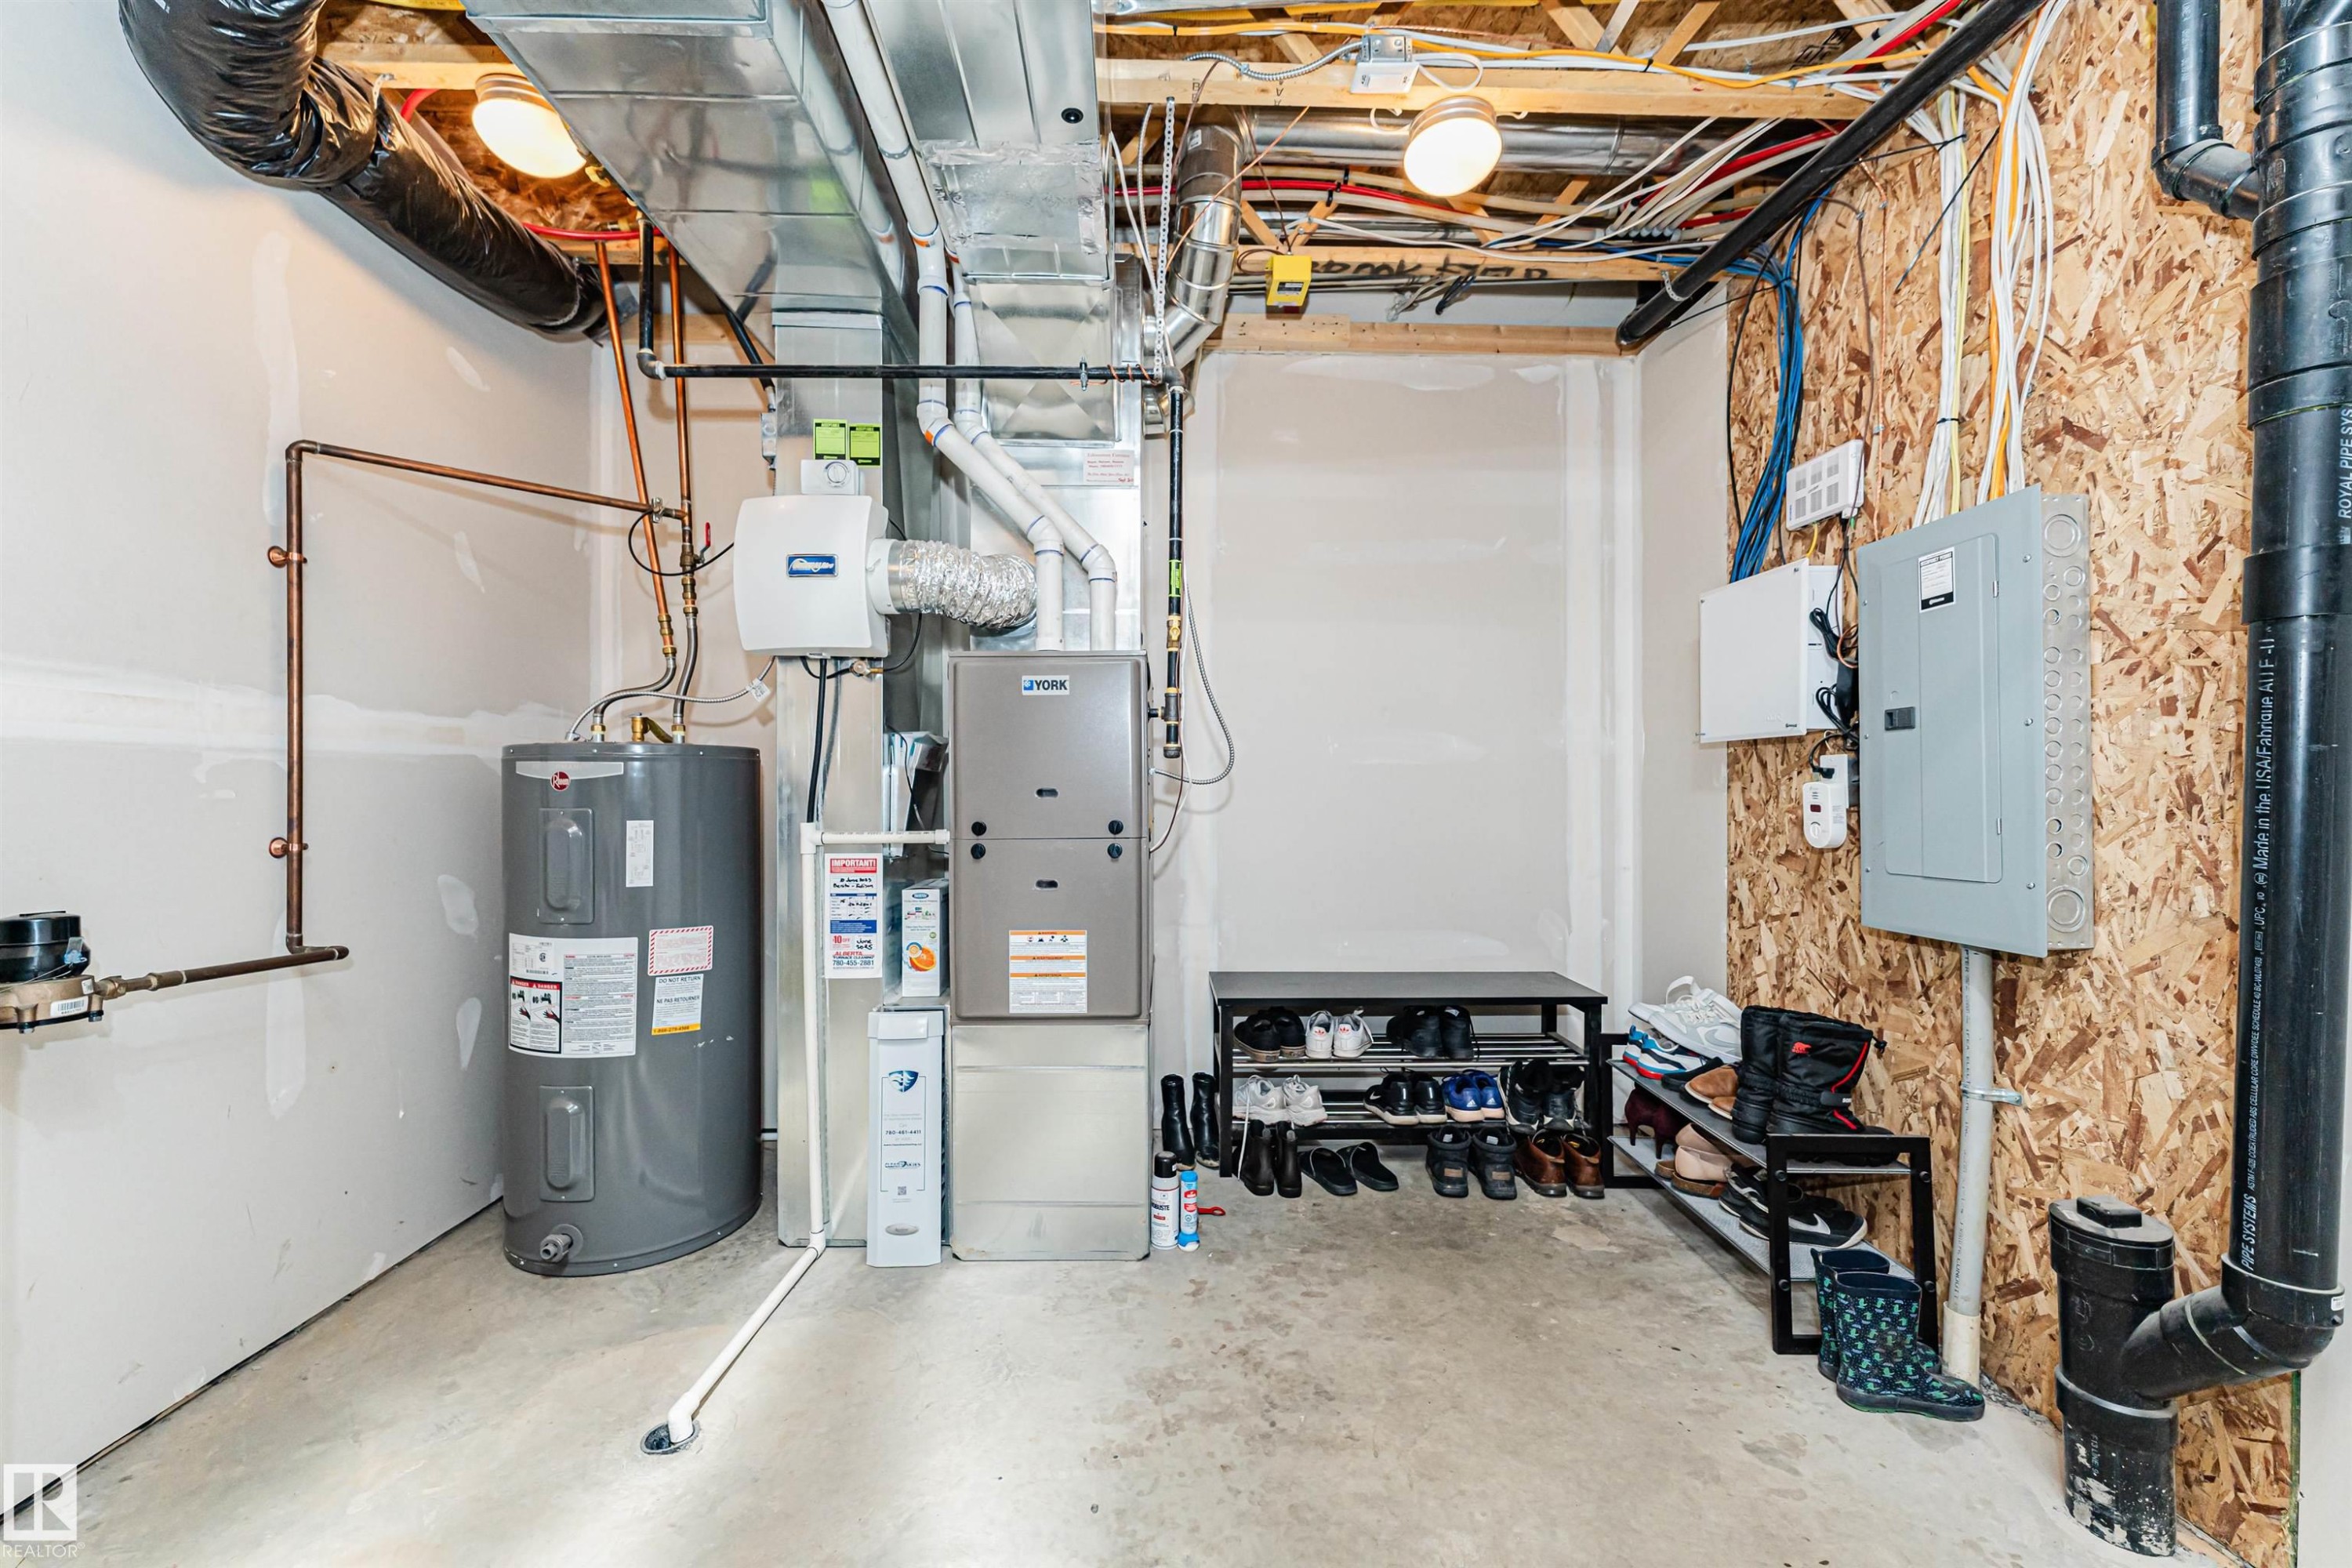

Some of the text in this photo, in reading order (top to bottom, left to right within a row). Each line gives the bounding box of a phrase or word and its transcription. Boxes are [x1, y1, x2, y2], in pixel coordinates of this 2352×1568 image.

[2339, 439, 2352, 469] PIPE
[2339, 473, 2352, 519] ROYAL
[1034, 679, 1069, 691] YORK
[2254, 793, 2270, 815] the
[2254, 818, 2270, 830] in
[2252, 833, 2270, 869] Made
[831, 859, 876, 868] IMPORTANT!
[2252, 991, 2261, 1000] 40
[2251, 1000, 2261, 1031] SCHEDULE
[2249, 1058, 2259, 1076] CORE
[2248, 1076, 2258, 1106] CELLULAR
[2248, 1106, 2257, 1119] ABS
[2247, 1174, 2256, 1191] ASTM
[2242, 1193, 2256, 1244] SYSTEMS
[2241, 1245, 2255, 1271] PIPE
